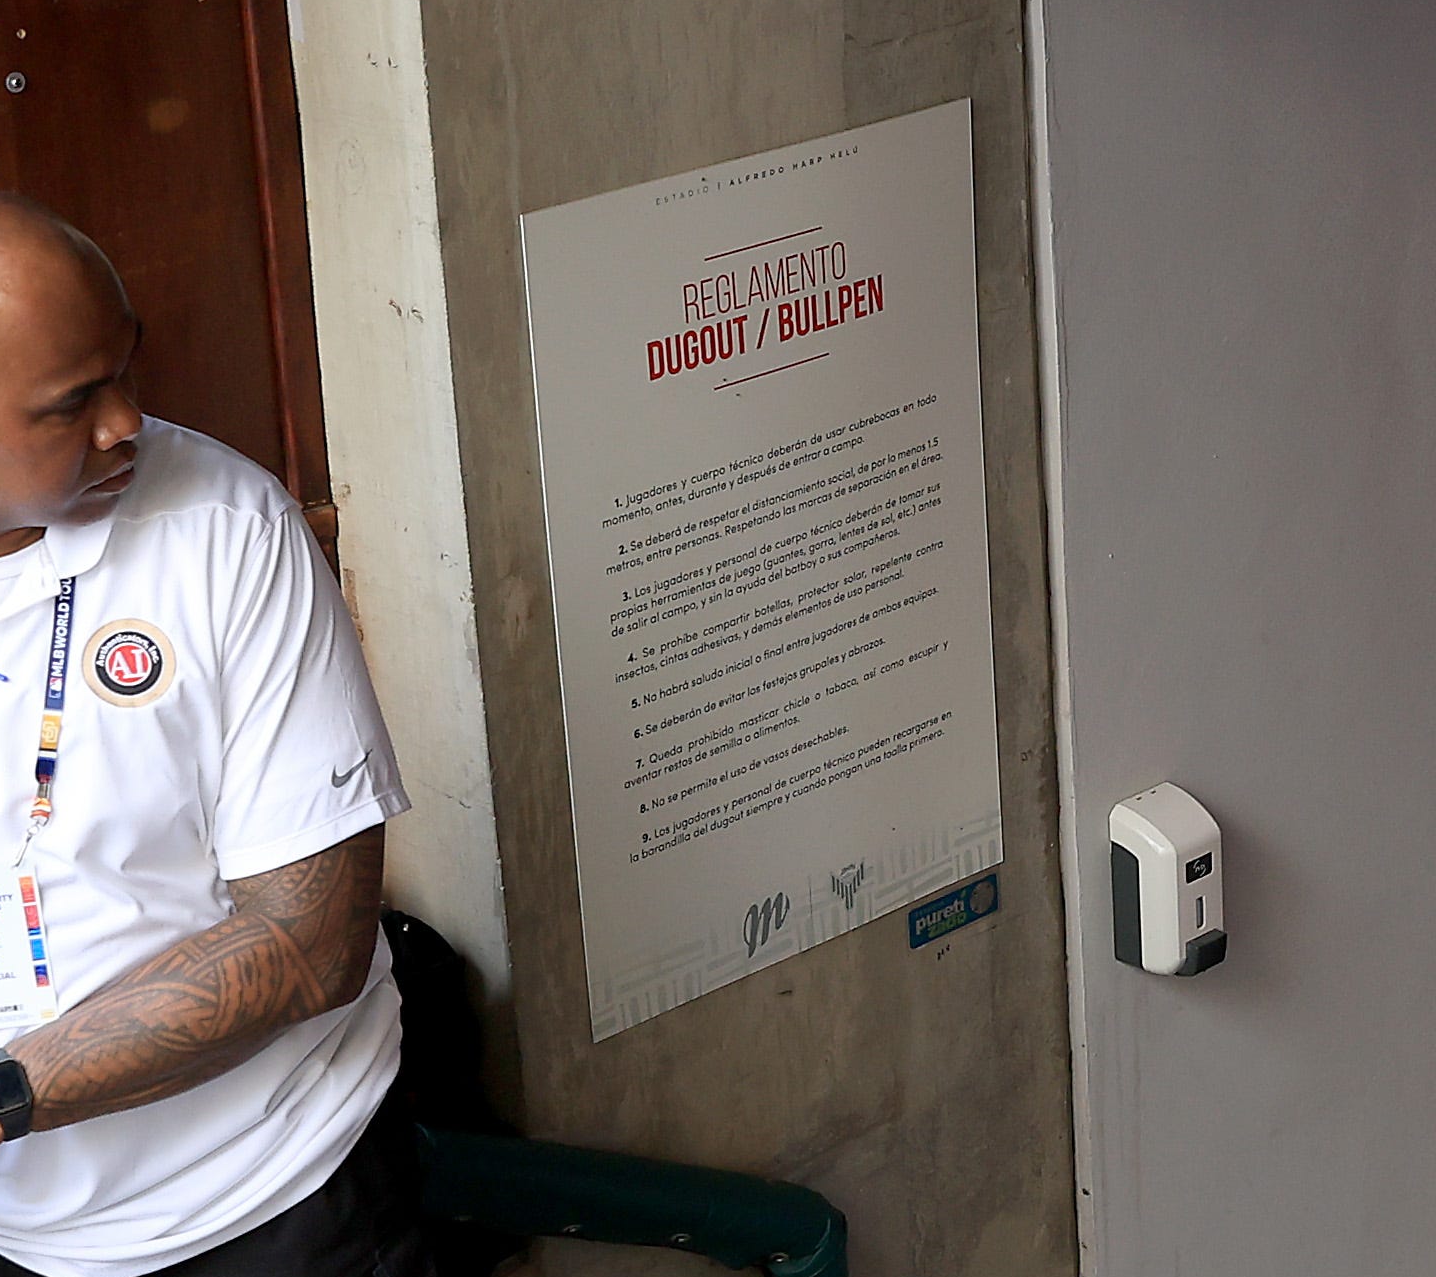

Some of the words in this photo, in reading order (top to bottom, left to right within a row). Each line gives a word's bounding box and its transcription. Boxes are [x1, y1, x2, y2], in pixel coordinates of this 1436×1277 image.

[729, 166, 785, 187] ALFREDO
[647, 315, 748, 381] DUGOUT
[757, 308, 770, 350] /
[778, 274, 883, 342] BULLPEN
[683, 242, 846, 324] REGLAMENTO
[602, 506, 653, 528] momento,
[655, 496, 685, 511] antes,
[687, 481, 726, 500] durante
[728, 479, 734, 490] y
[736, 464, 776, 484] después
[778, 460, 790, 470] de
[792, 449, 821, 466] entrar
[823, 447, 829, 455] a
[831, 436, 864, 452] campo.
[614, 497, 622, 507] 1.
[680, 478, 687, 490] y
[690, 466, 725, 484] cuerpo
[729, 454, 763, 472] técnico
[766, 439, 807, 459] deberán
[810, 433, 822, 444] de
[825, 426, 846, 439] usar
[848, 407, 900, 431] cubrebocas
[902, 402, 914, 412] en
[916, 393, 936, 407] todo
[618, 544, 628, 555] 2.
[629, 540, 643, 551] Se
[645, 525, 681, 546] deberá
[683, 522, 696, 533] de
[698, 508, 739, 529] respetar
[741, 502, 750, 514] el
[752, 479, 825, 510] distanciamiento
[827, 466, 855, 484] social,
[857, 462, 868, 474] de
[871, 457, 886, 472] por
[887, 453, 896, 463] lo
[897, 443, 925, 460] menos
[927, 436, 938, 448] 1.5
[605, 557, 643, 575] metros,
[646, 547, 672, 562] entre
[674, 531, 722, 555] personas.
[724, 509, 780, 536] Respetando
[782, 505, 796, 516] las
[798, 492, 832, 511] marcas
[834, 486, 845, 497] de
[848, 469, 896, 493] separación
[898, 464, 909, 474] en
[911, 457, 919, 469] el
[920, 453, 943, 466] área.
[52, 651, 67, 677] MLB
[54, 603, 72, 654] WORLD
[631, 698, 641, 708] 5.
[643, 693, 657, 704] No
[659, 679, 689, 698] habrá
[691, 668, 723, 687] saludo
[725, 655, 752, 674] inicial
[755, 655, 761, 663] o
[763, 643, 784, 660] final
[786, 636, 810, 651] entre
[811, 618, 856, 645] jugadores
[858, 612, 870, 623] de
[872, 601, 901, 618] ambos
[903, 587, 938, 606] equipos.
[633, 728, 643, 738] 6.
[644, 723, 657, 734] Se
[660, 707, 701, 729] deberán
[703, 701, 716, 712] de
[718, 691, 745, 707] evitar
[747, 685, 760, 696] los
[762, 671, 797, 691] festejos
[799, 655, 839, 679] grupales
[840, 652, 846, 662] y
[848, 637, 886, 657] abrazos.
[639, 803, 649, 813] 8.
[651, 797, 665, 809] No
[667, 793, 678, 803] se
[680, 777, 717, 800] permite
[719, 770, 728, 782] el
[730, 766, 747, 778] uso
[749, 759, 761, 770] de
[762, 749, 788, 764] vasos
[791, 725, 849, 754] desechables.
